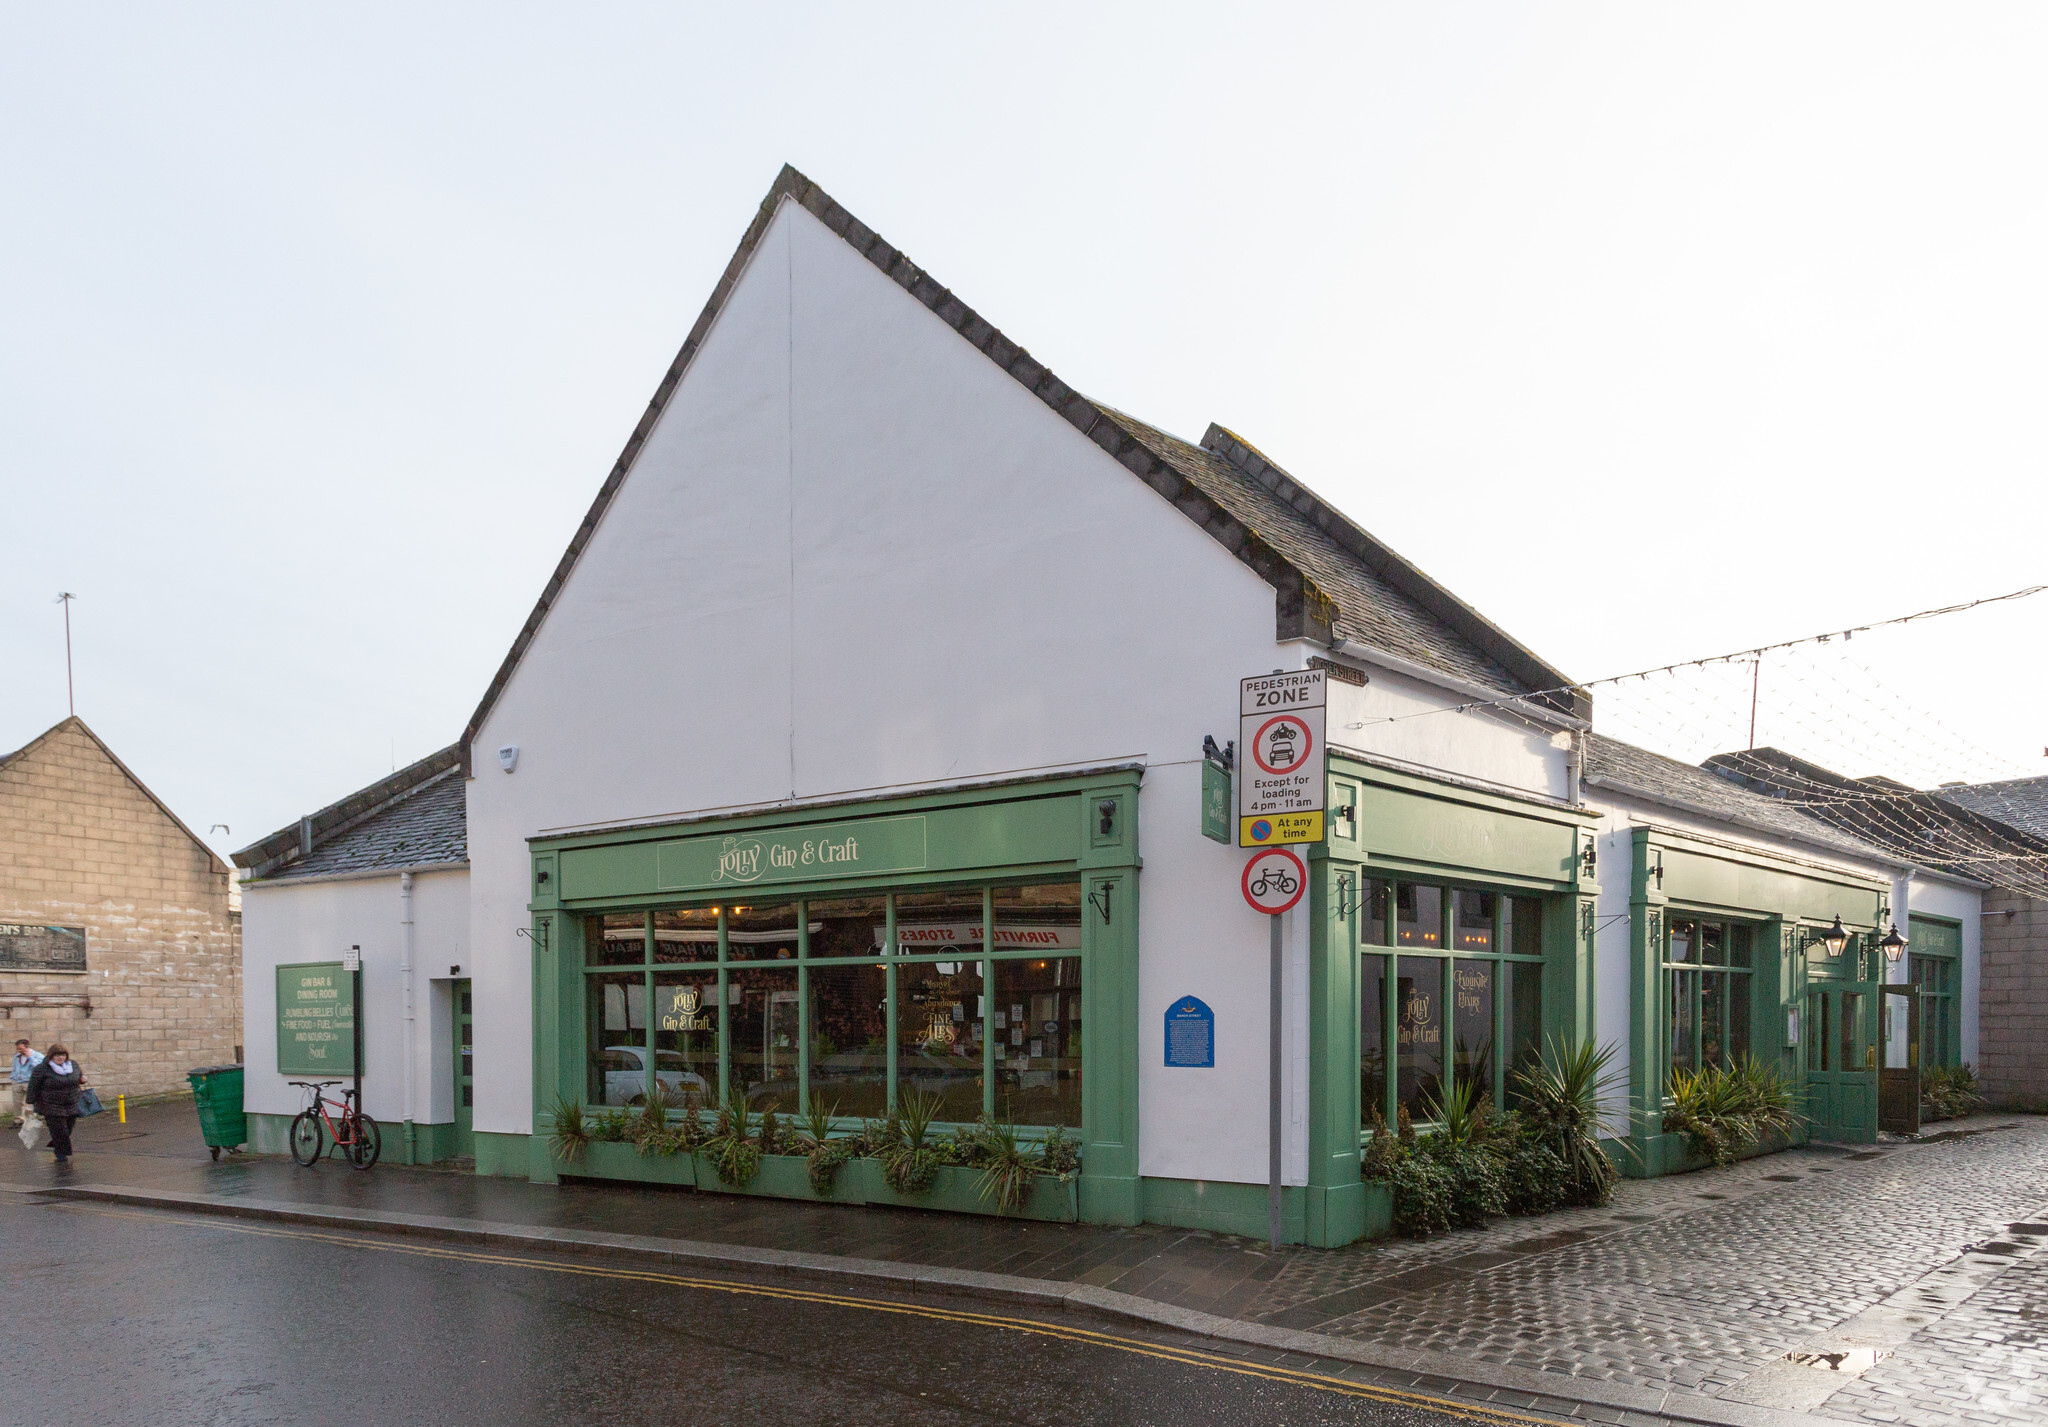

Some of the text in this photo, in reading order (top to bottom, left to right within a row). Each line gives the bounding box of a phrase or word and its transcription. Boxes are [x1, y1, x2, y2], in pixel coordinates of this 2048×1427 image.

[1339, 664, 1364, 683] STREET
[1246, 674, 1321, 692] PEDESTRIAN
[1256, 687, 1309, 707] ZONE
[1254, 776, 1309, 788] Except for
[1262, 788, 1301, 799] loading
[1251, 802, 1259, 811] 4
[1260, 803, 1276, 811] pm
[1285, 798, 1293, 808] 11
[1296, 799, 1312, 807] am
[1277, 818, 1312, 828] At any
[1283, 829, 1307, 838] time
[770, 844, 798, 869] Gin
[801, 840, 815, 865] &
[818, 837, 860, 864] Craft
[312, 977, 325, 987] BAR
[297, 989, 338, 1000] DINING ROOM
[312, 1007, 333, 1017] BELLIES
[297, 1020, 312, 1029] FOOD
[317, 1020, 331, 1029] FUEL
[662, 1014, 710, 1031] Gin & Craft
[1412, 1024, 1421, 1043] &
[1421, 1025, 1440, 1043] Craft
